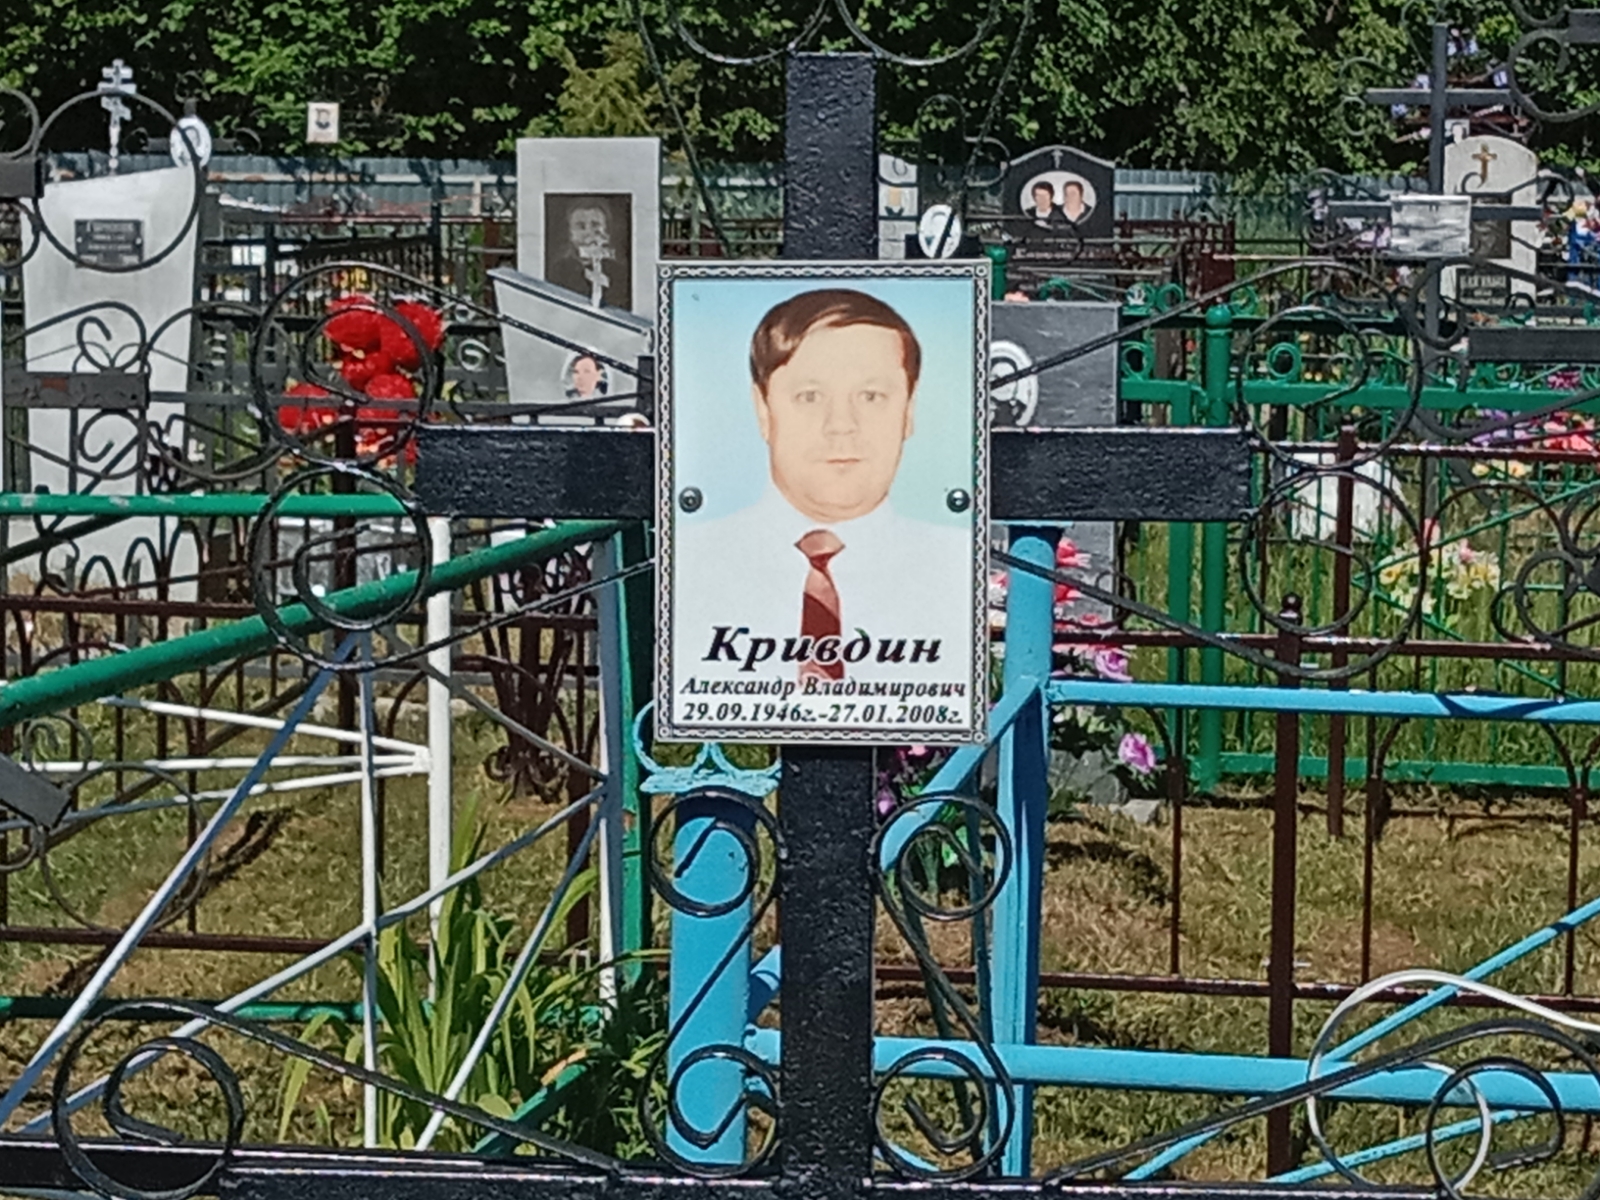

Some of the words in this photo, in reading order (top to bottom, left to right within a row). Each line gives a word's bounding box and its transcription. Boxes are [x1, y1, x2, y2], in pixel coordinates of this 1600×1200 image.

[702, 626, 942, 672] Кривдин
[680, 677, 796, 700] Александр
[803, 676, 966, 701] Владимирович
